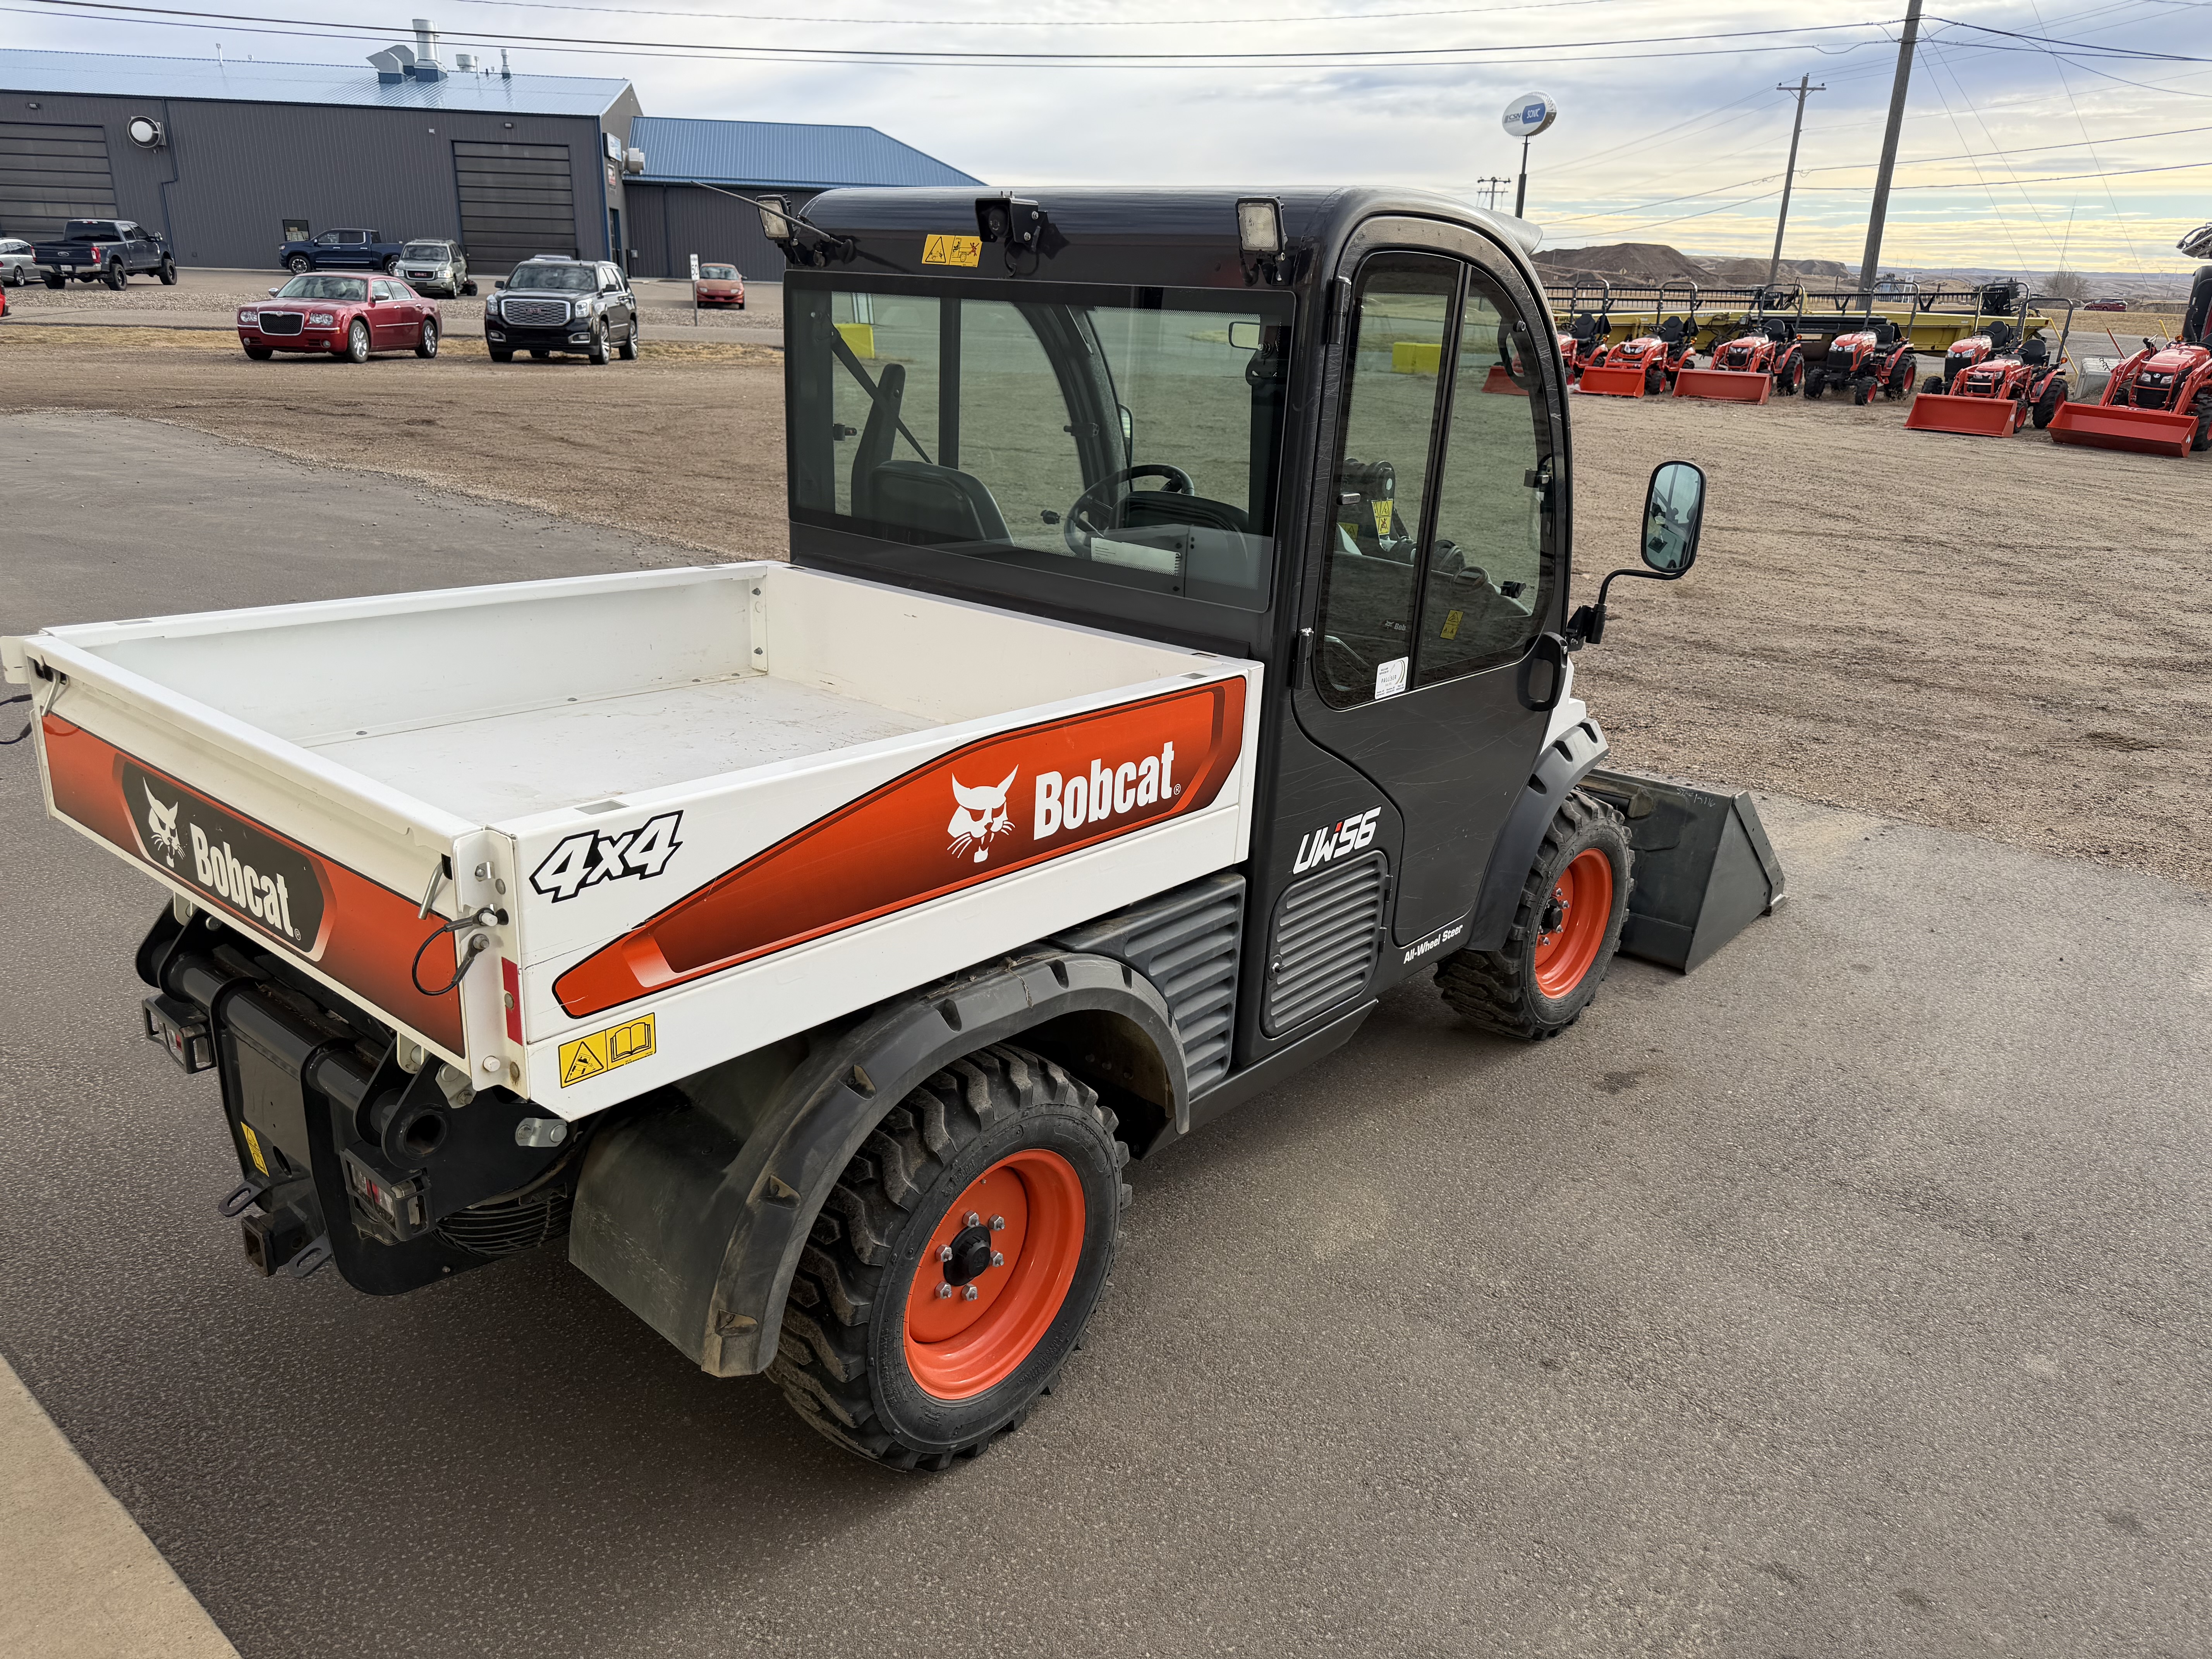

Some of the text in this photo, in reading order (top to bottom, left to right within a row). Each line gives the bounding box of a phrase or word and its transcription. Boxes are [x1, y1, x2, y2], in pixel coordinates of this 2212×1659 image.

[1381, 675, 1397, 684] PALLISER
[1034, 741, 1175, 841] Bobcat
[190, 823, 295, 938] Bobcat
[529, 810, 684, 903] 4x4
[1404, 924, 1463, 964] All-Wheel Steer
